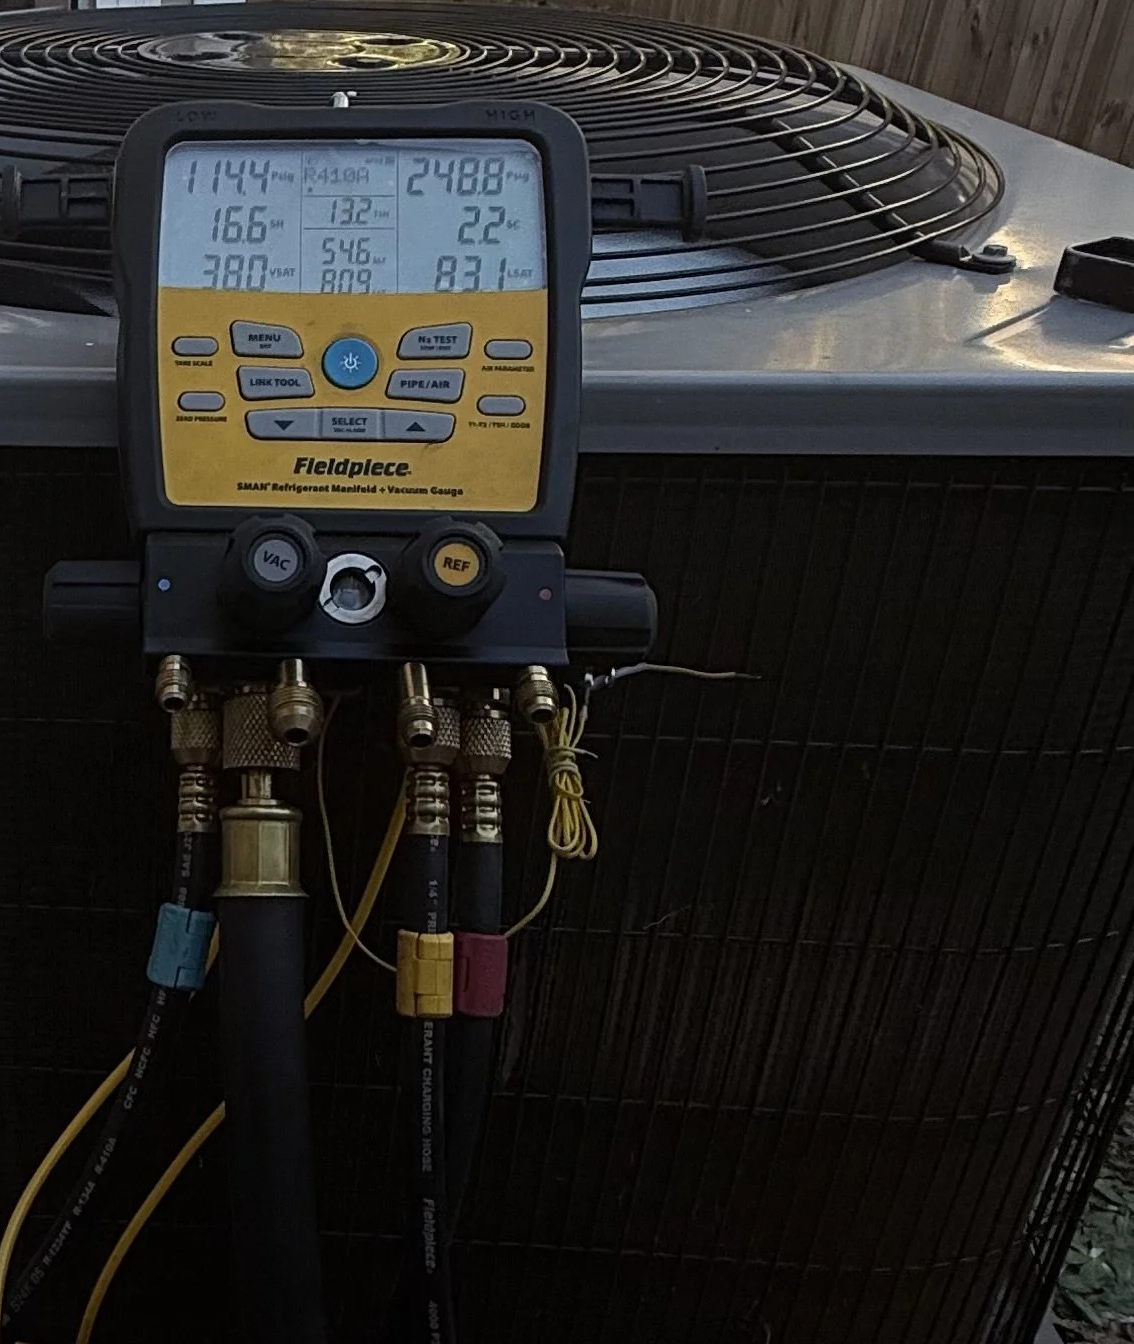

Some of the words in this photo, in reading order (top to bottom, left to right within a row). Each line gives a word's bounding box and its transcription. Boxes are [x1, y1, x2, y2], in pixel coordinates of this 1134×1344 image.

[484, 108, 536, 123] HIGH
[188, 160, 270, 196] 114.4
[304, 166, 370, 184] R410A
[407, 157, 505, 196] 248.8
[211, 205, 268, 244] 16.6
[457, 206, 506, 245] 2.2
[269, 268, 296, 278] VSAT
[507, 268, 534, 278] LSAT
[248, 334, 281, 343] MENU
[433, 335, 458, 345] TEST
[250, 378, 272, 387] LINK
[275, 378, 301, 387] TOOL
[332, 417, 368, 426] SELECT
[294, 457, 409, 478] Fieldpiece
[271, 482, 329, 494] Refrigerant
[331, 483, 377, 494] Manifold
[388, 485, 428, 495] Vacuum
[430, 486, 464, 497] Gauge
[263, 550, 291, 571] VAC
[443, 556, 471, 573] REF
[123, 1084, 138, 1111] CFC
[147, 1013, 162, 1039] HFC
[422, 1067, 435, 1135] CHARGING
[421, 1136, 434, 1173] HOSE
